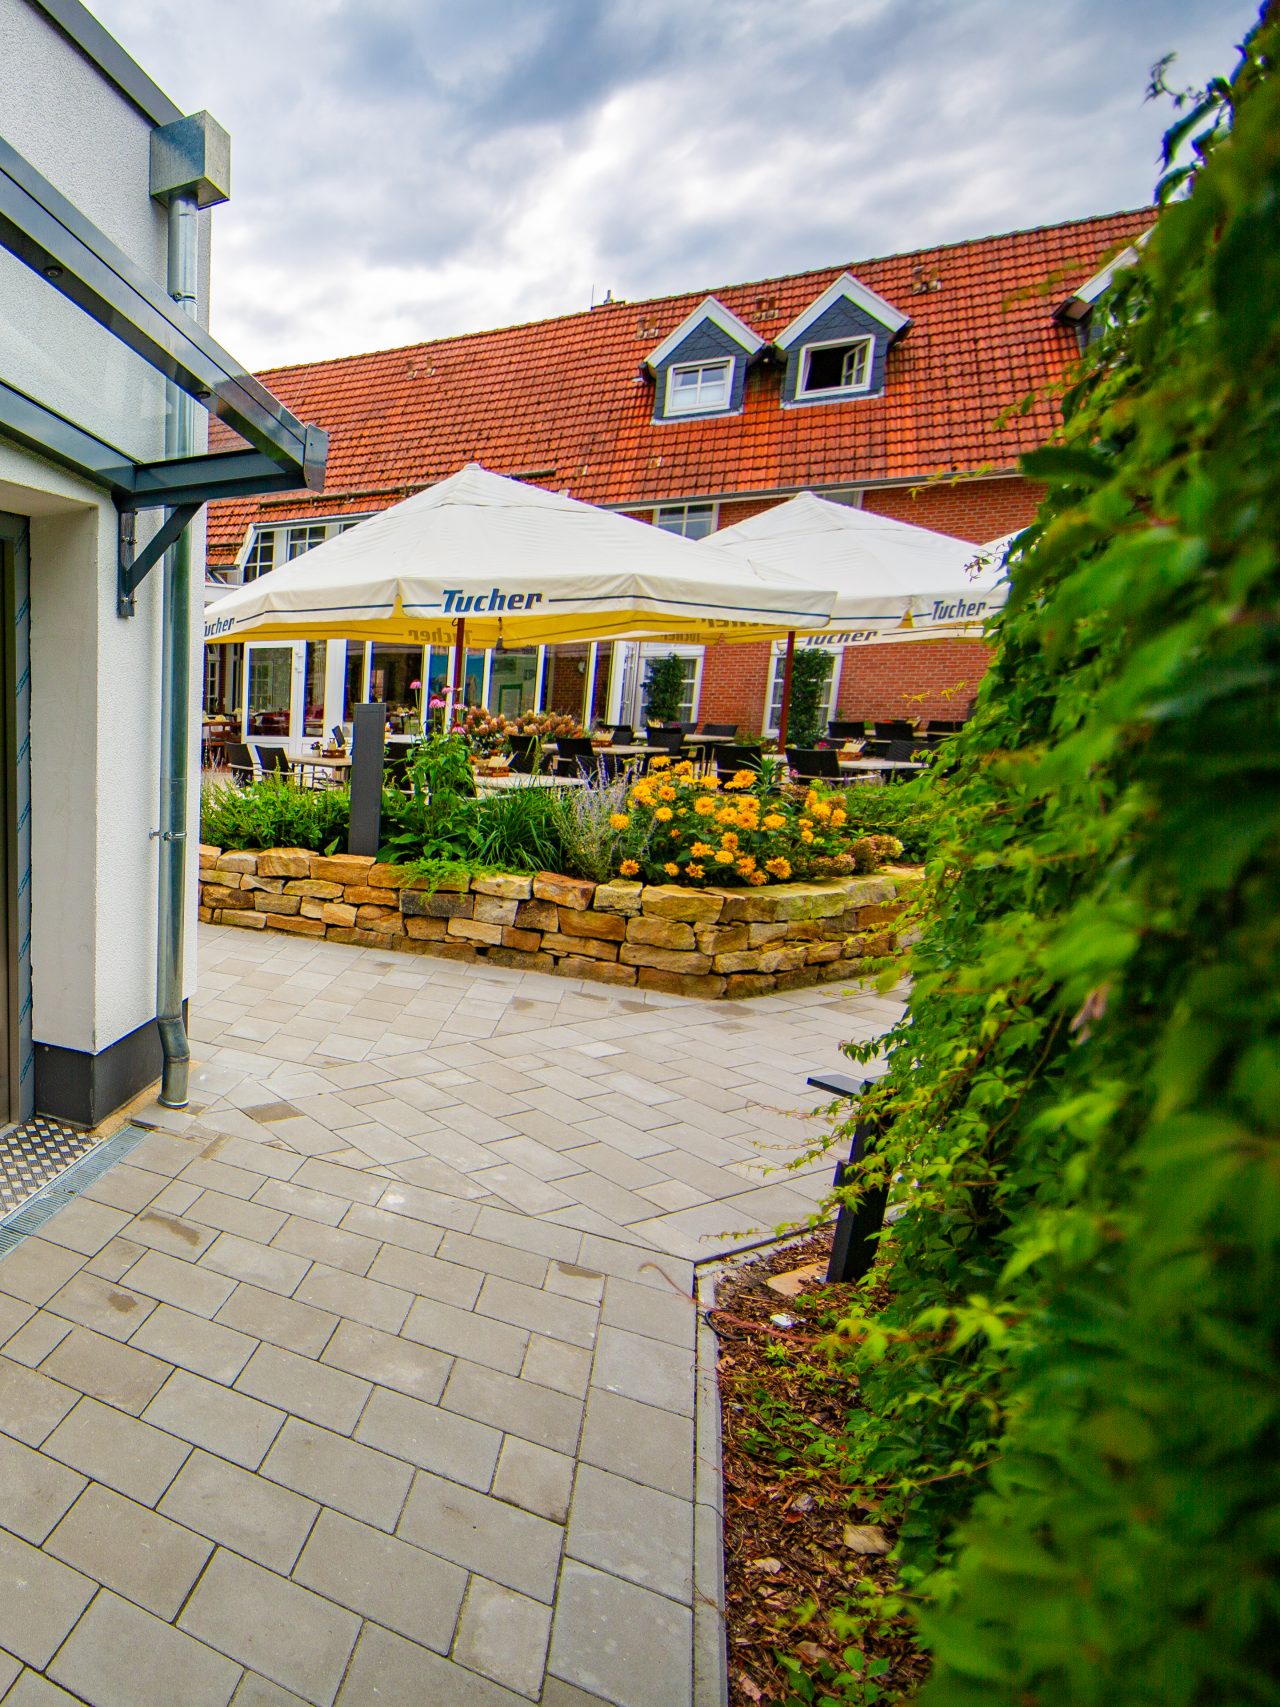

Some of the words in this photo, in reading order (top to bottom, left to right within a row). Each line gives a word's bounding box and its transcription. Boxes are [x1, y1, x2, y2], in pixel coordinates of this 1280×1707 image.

[443, 588, 543, 613] Tucher
[932, 599, 987, 621] Tucher
[204, 616, 236, 637] ucher
